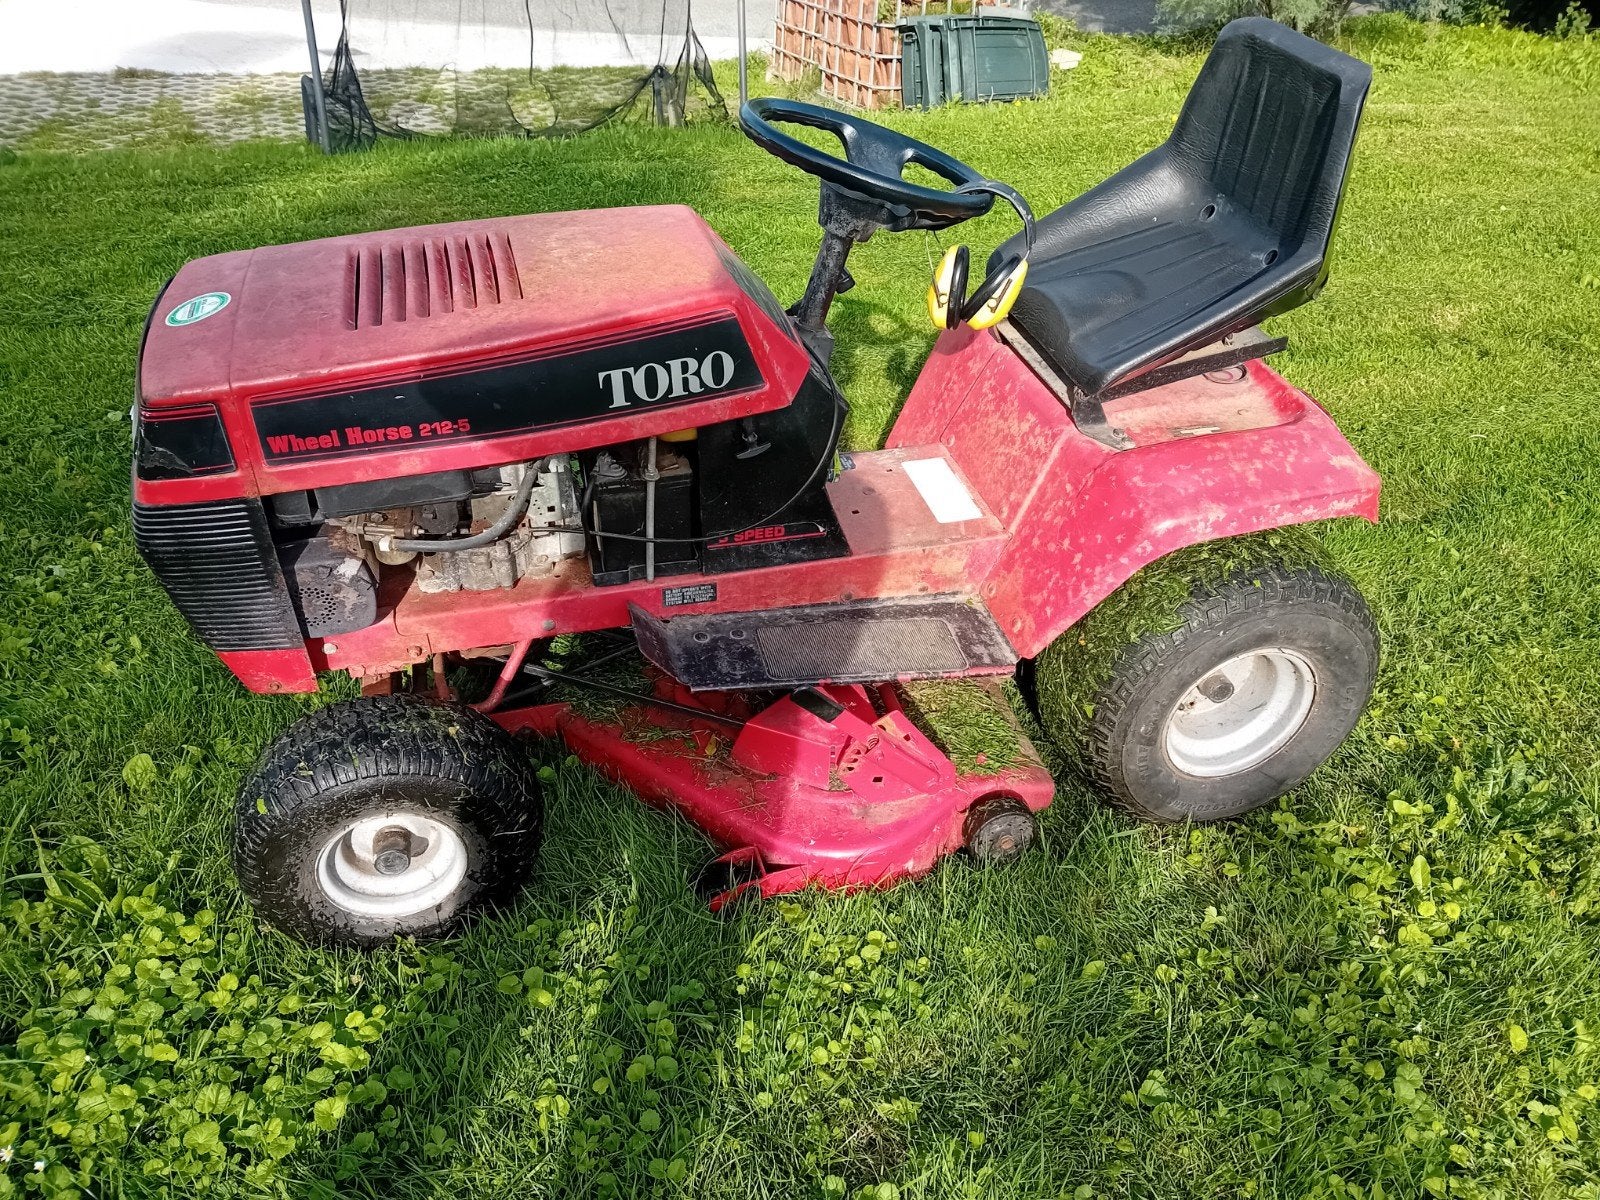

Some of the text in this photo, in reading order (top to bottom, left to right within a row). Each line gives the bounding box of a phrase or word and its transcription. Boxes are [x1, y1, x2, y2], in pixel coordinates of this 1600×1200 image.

[598, 350, 735, 408] TORO
[266, 418, 471, 454] Wheel Horse 212-5
[733, 526, 785, 543] SPEED
